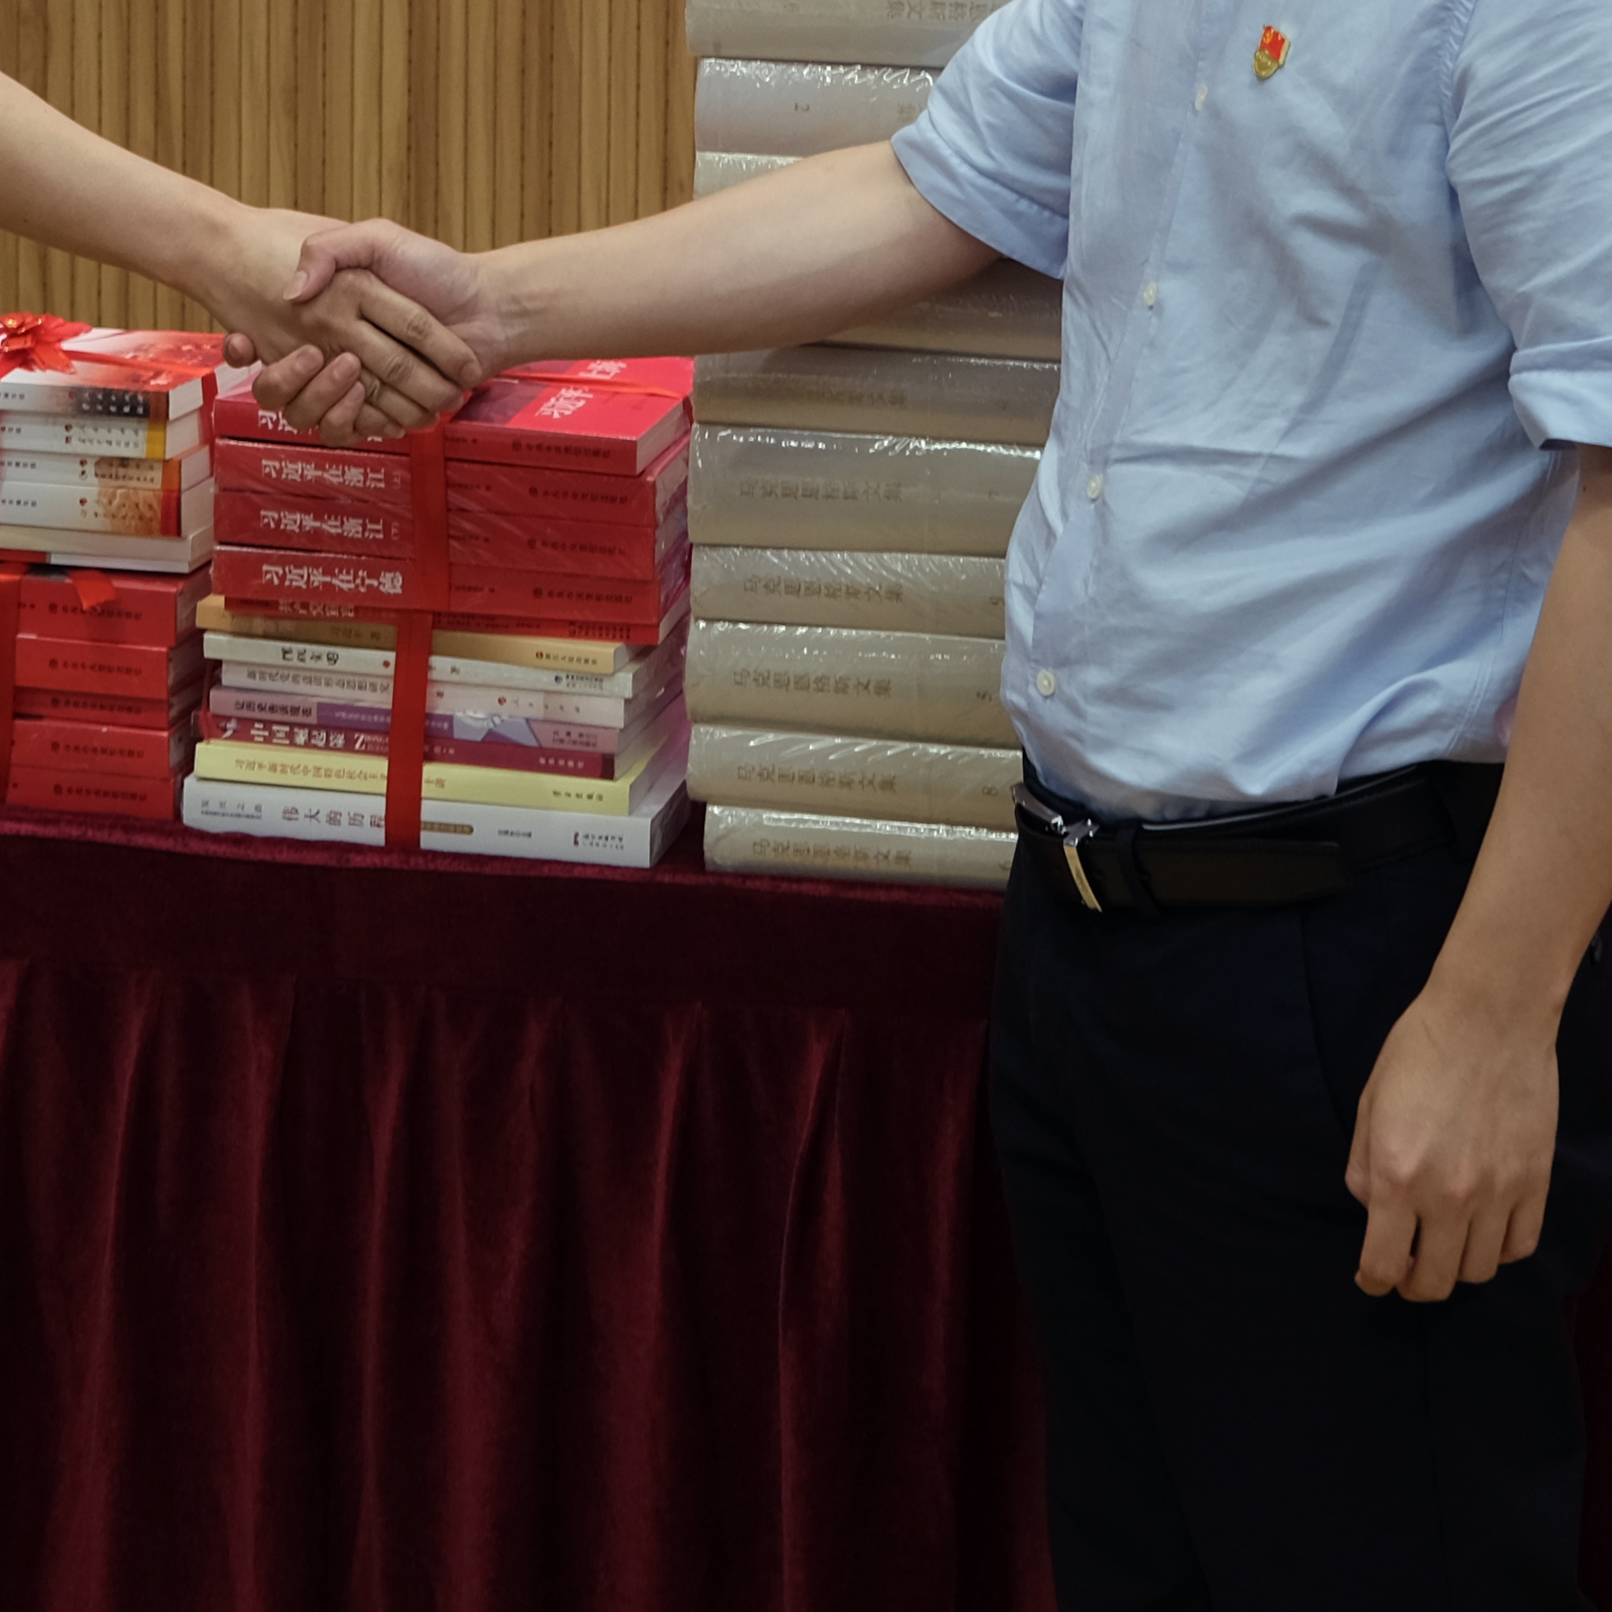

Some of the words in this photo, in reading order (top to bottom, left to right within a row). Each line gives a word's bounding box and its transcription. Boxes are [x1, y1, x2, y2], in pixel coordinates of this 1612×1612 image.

[261, 459, 386, 489] 习近平在浙江
[260, 510, 385, 540] 习近平在浙江
[262, 563, 404, 596] 习近平在宁德
[743, 576, 905, 603] 马克思恩格斯文集
[733, 670, 892, 697] 马克思恩格斯文集
[737, 764, 897, 794] 马克思恩格斯文集
[282, 806, 387, 831] 伟大的历程
[752, 838, 912, 868] 马克思恩格斯文集
